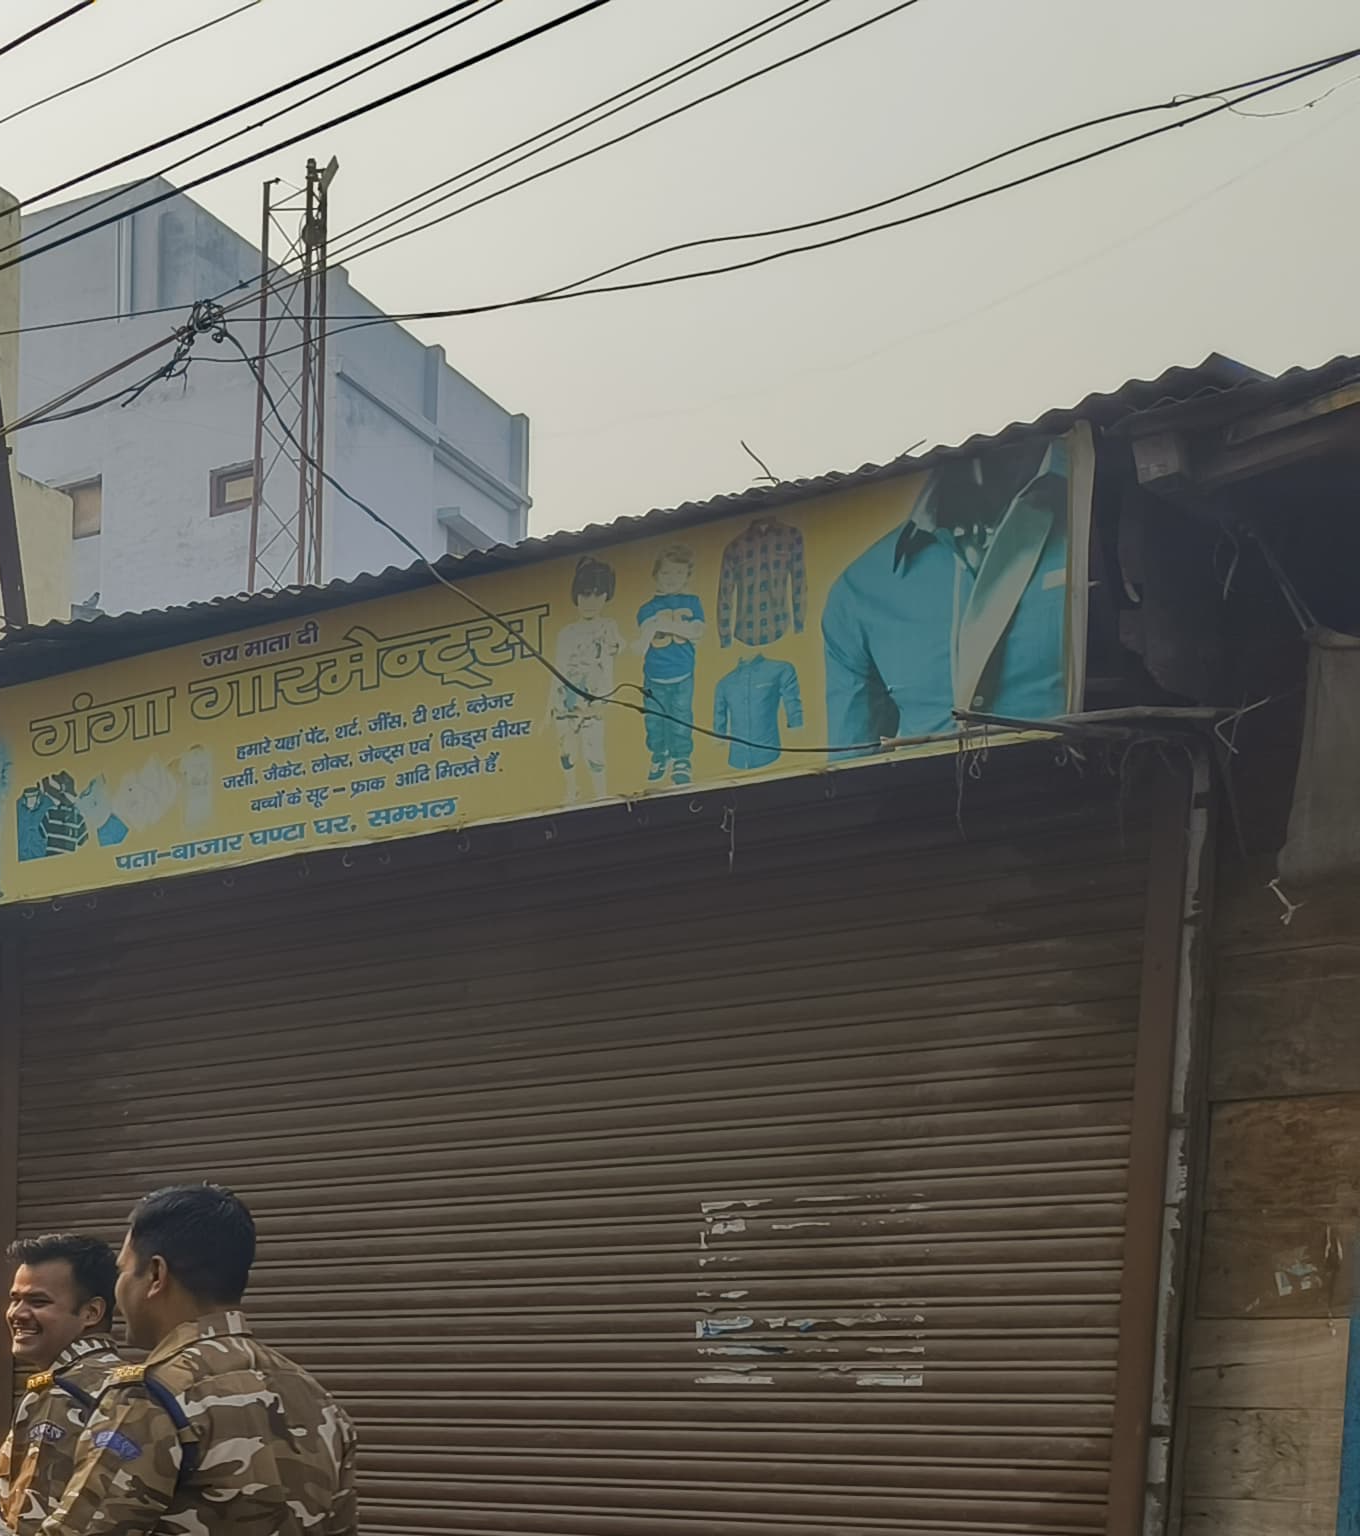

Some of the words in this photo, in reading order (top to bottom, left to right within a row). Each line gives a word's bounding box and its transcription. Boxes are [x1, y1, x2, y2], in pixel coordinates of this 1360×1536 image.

[201, 643, 239, 667] जय
[244, 631, 291, 658] माता
[296, 620, 319, 645] दी
[30, 692, 177, 757] गंगा
[236, 737, 272, 760] हमारे
[412, 704, 427, 724] टी
[287, 787, 302, 806] के
[395, 763, 430, 787] आदि
[435, 755, 481, 780] मिलते
[249, 823, 306, 847] घण्टा
[367, 797, 458, 828] सम्भल
